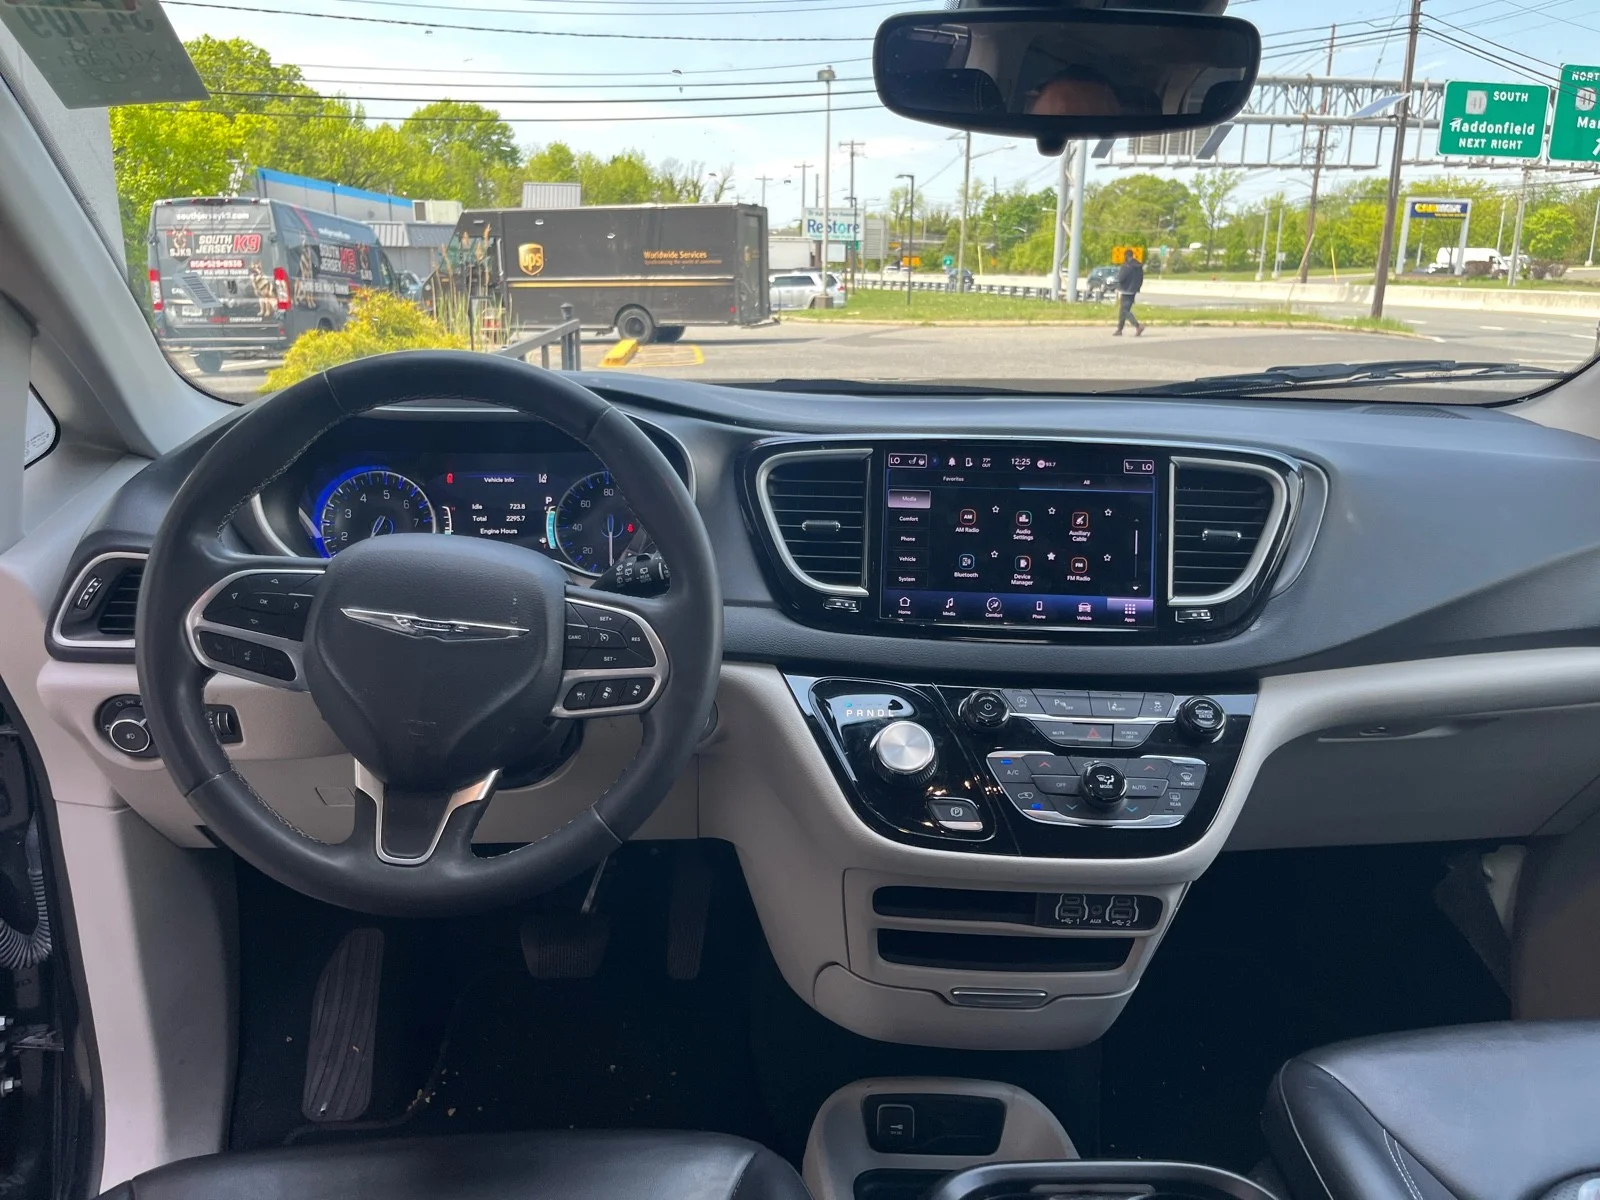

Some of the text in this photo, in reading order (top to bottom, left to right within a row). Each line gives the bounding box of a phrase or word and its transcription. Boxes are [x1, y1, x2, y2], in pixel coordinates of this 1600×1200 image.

[1493, 91, 1529, 102] SOUTH
[1450, 119, 1535, 136] Haddonfield
[1459, 138, 1523, 150] NEXT RIGHT
[807, 219, 860, 234] ReStore
[199, 235, 232, 244] SOUTH
[233, 234, 262, 254] K9
[195, 244, 232, 254] JERSEY
[643, 251, 707, 259] Worldwide Services
[521, 253, 542, 271] ups
[1011, 458, 1031, 466] 12:25
[1142, 463, 1153, 471] LO
[383, 490, 390, 499] 5
[603, 488, 614, 496] 80
[360, 493, 367, 503] 4
[403, 500, 410, 509] 6
[580, 500, 590, 508] 60
[344, 509, 352, 519] 3
[413, 518, 419, 527] 7
[341, 532, 348, 541] 2
